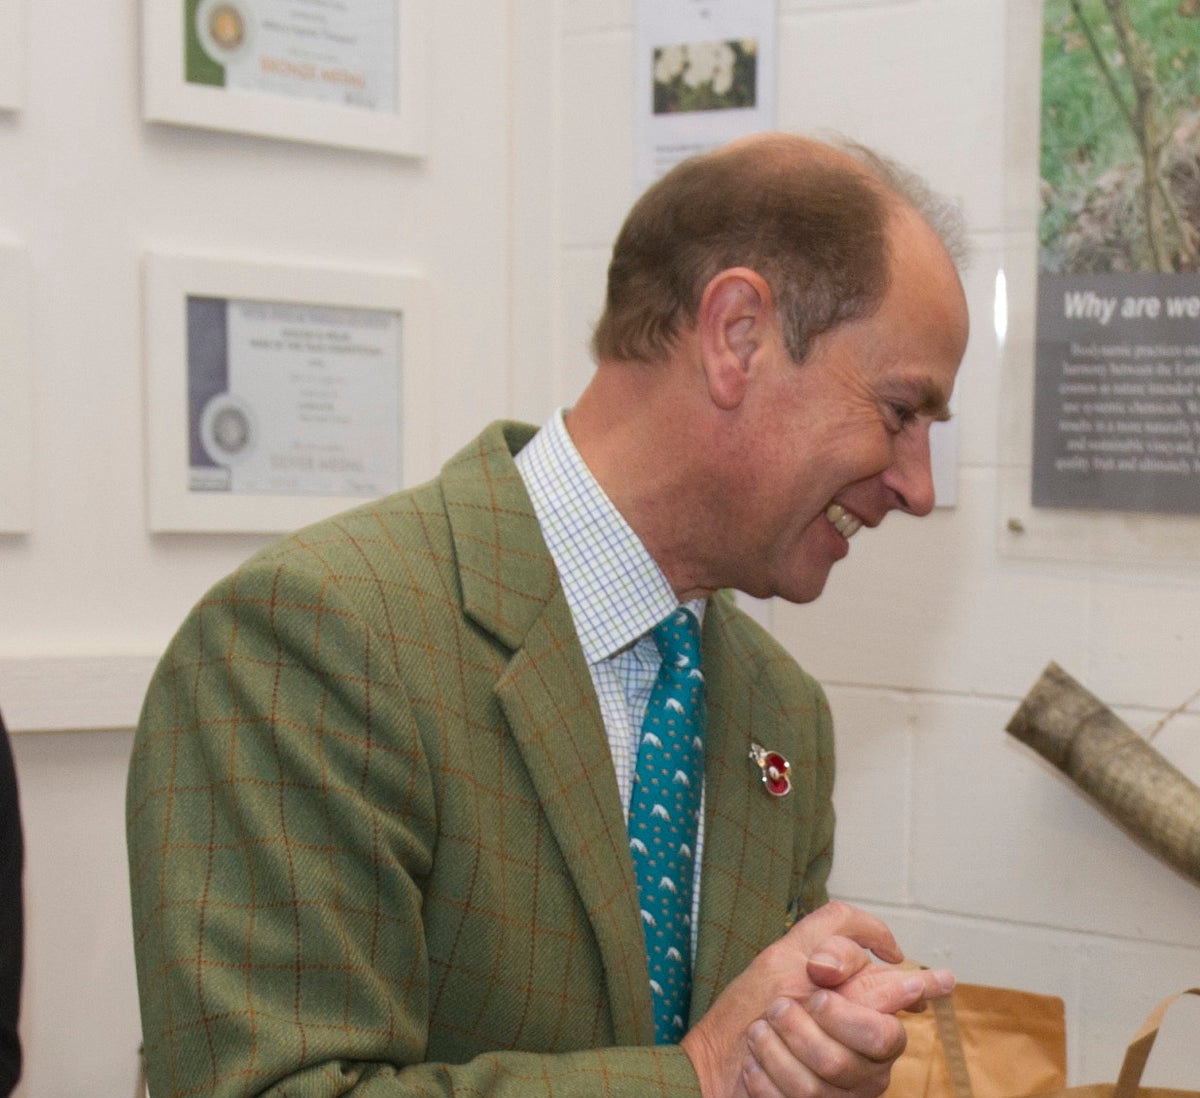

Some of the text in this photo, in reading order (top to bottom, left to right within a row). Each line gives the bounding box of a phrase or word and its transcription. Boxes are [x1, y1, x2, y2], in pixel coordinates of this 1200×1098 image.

[1063, 289, 1116, 326] Why
[1121, 294, 1160, 318] are
[1166, 294, 1200, 318] we
